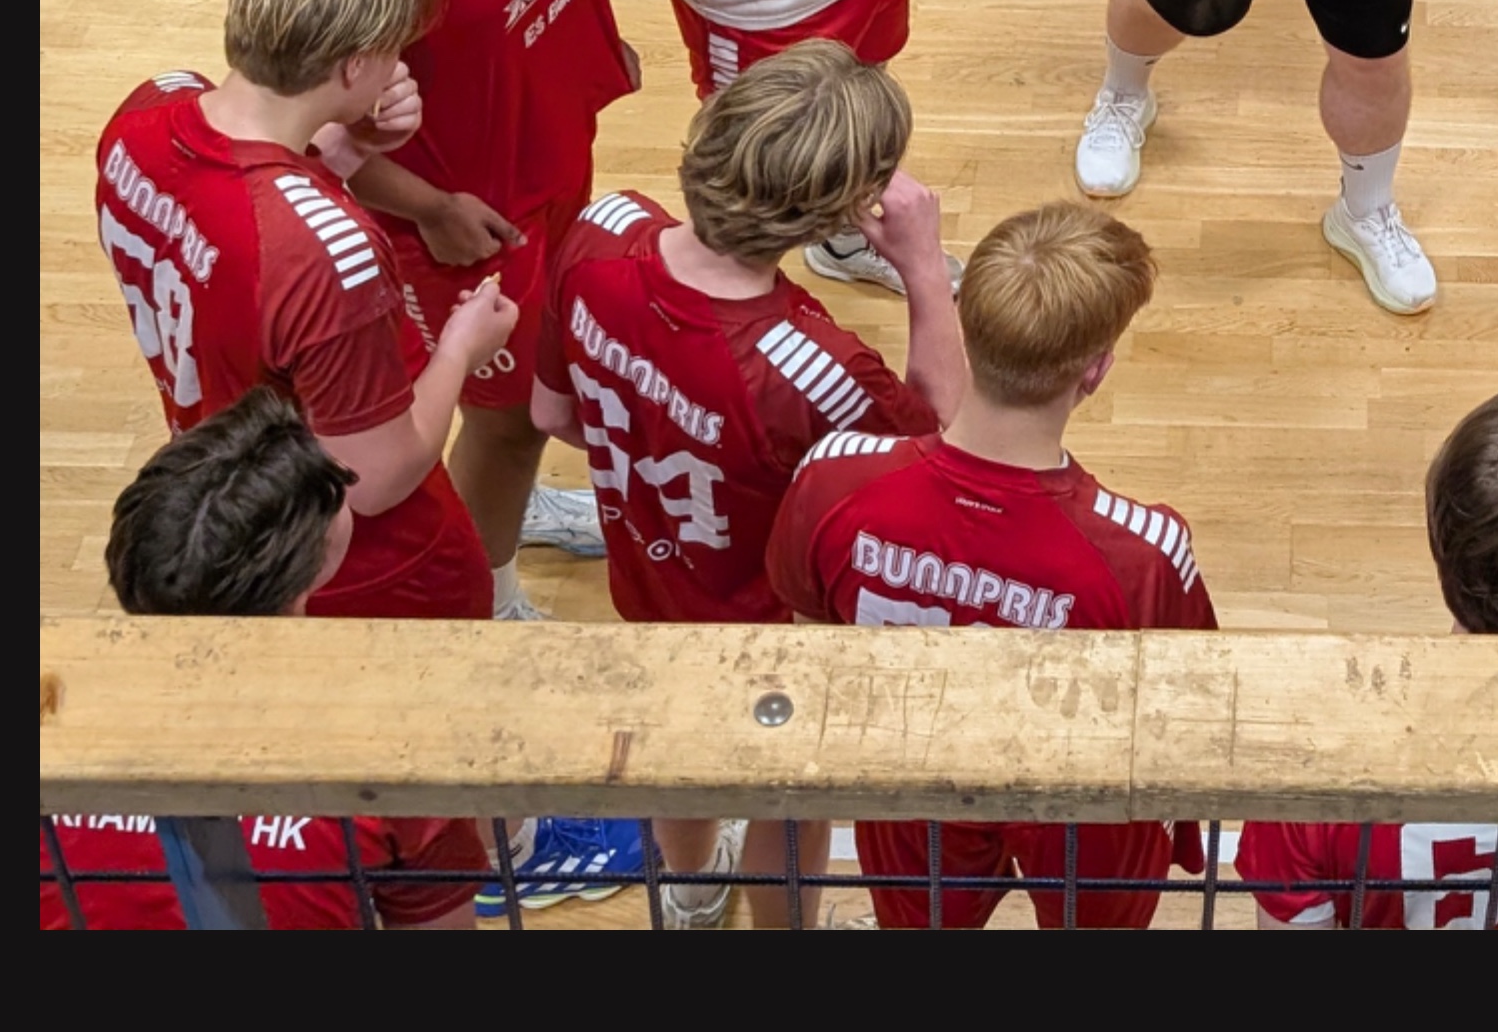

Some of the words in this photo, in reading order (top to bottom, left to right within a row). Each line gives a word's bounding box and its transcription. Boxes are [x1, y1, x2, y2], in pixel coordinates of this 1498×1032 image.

[102, 202, 203, 408] 58
[569, 294, 724, 446] BUNNPRIS
[852, 529, 1076, 630] BUNNPRIS
[251, 815, 312, 850] HK
